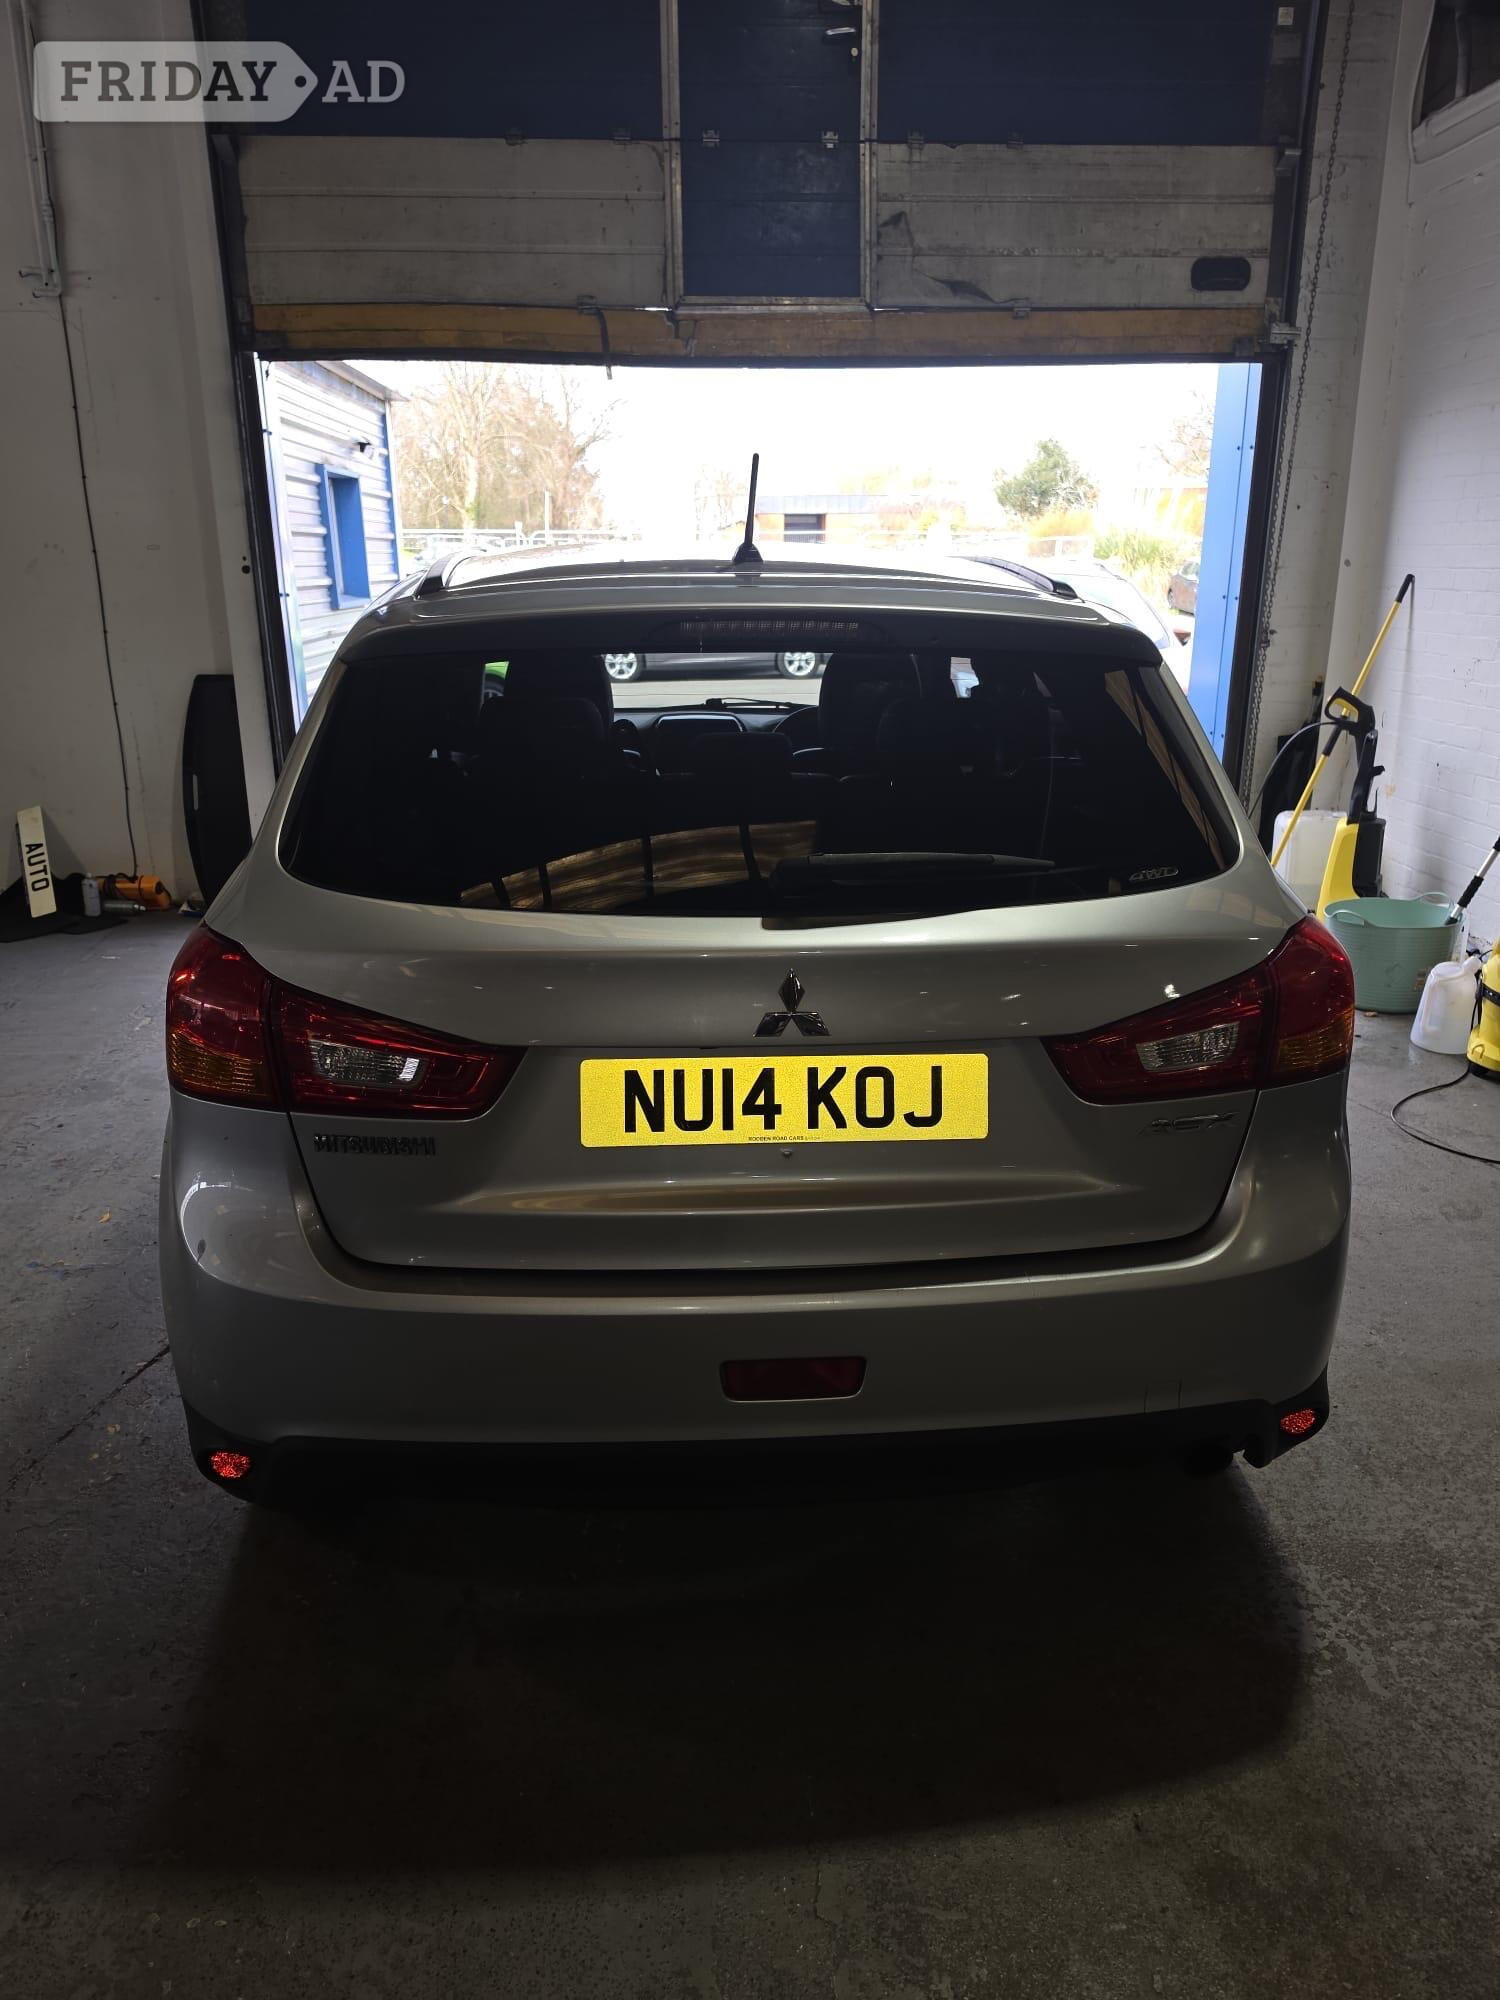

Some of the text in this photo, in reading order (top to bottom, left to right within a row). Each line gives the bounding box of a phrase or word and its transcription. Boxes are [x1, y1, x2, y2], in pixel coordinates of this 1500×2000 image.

[25, 843, 50, 892] AUTO
[624, 1065, 943, 1133] NU14 KOJ
